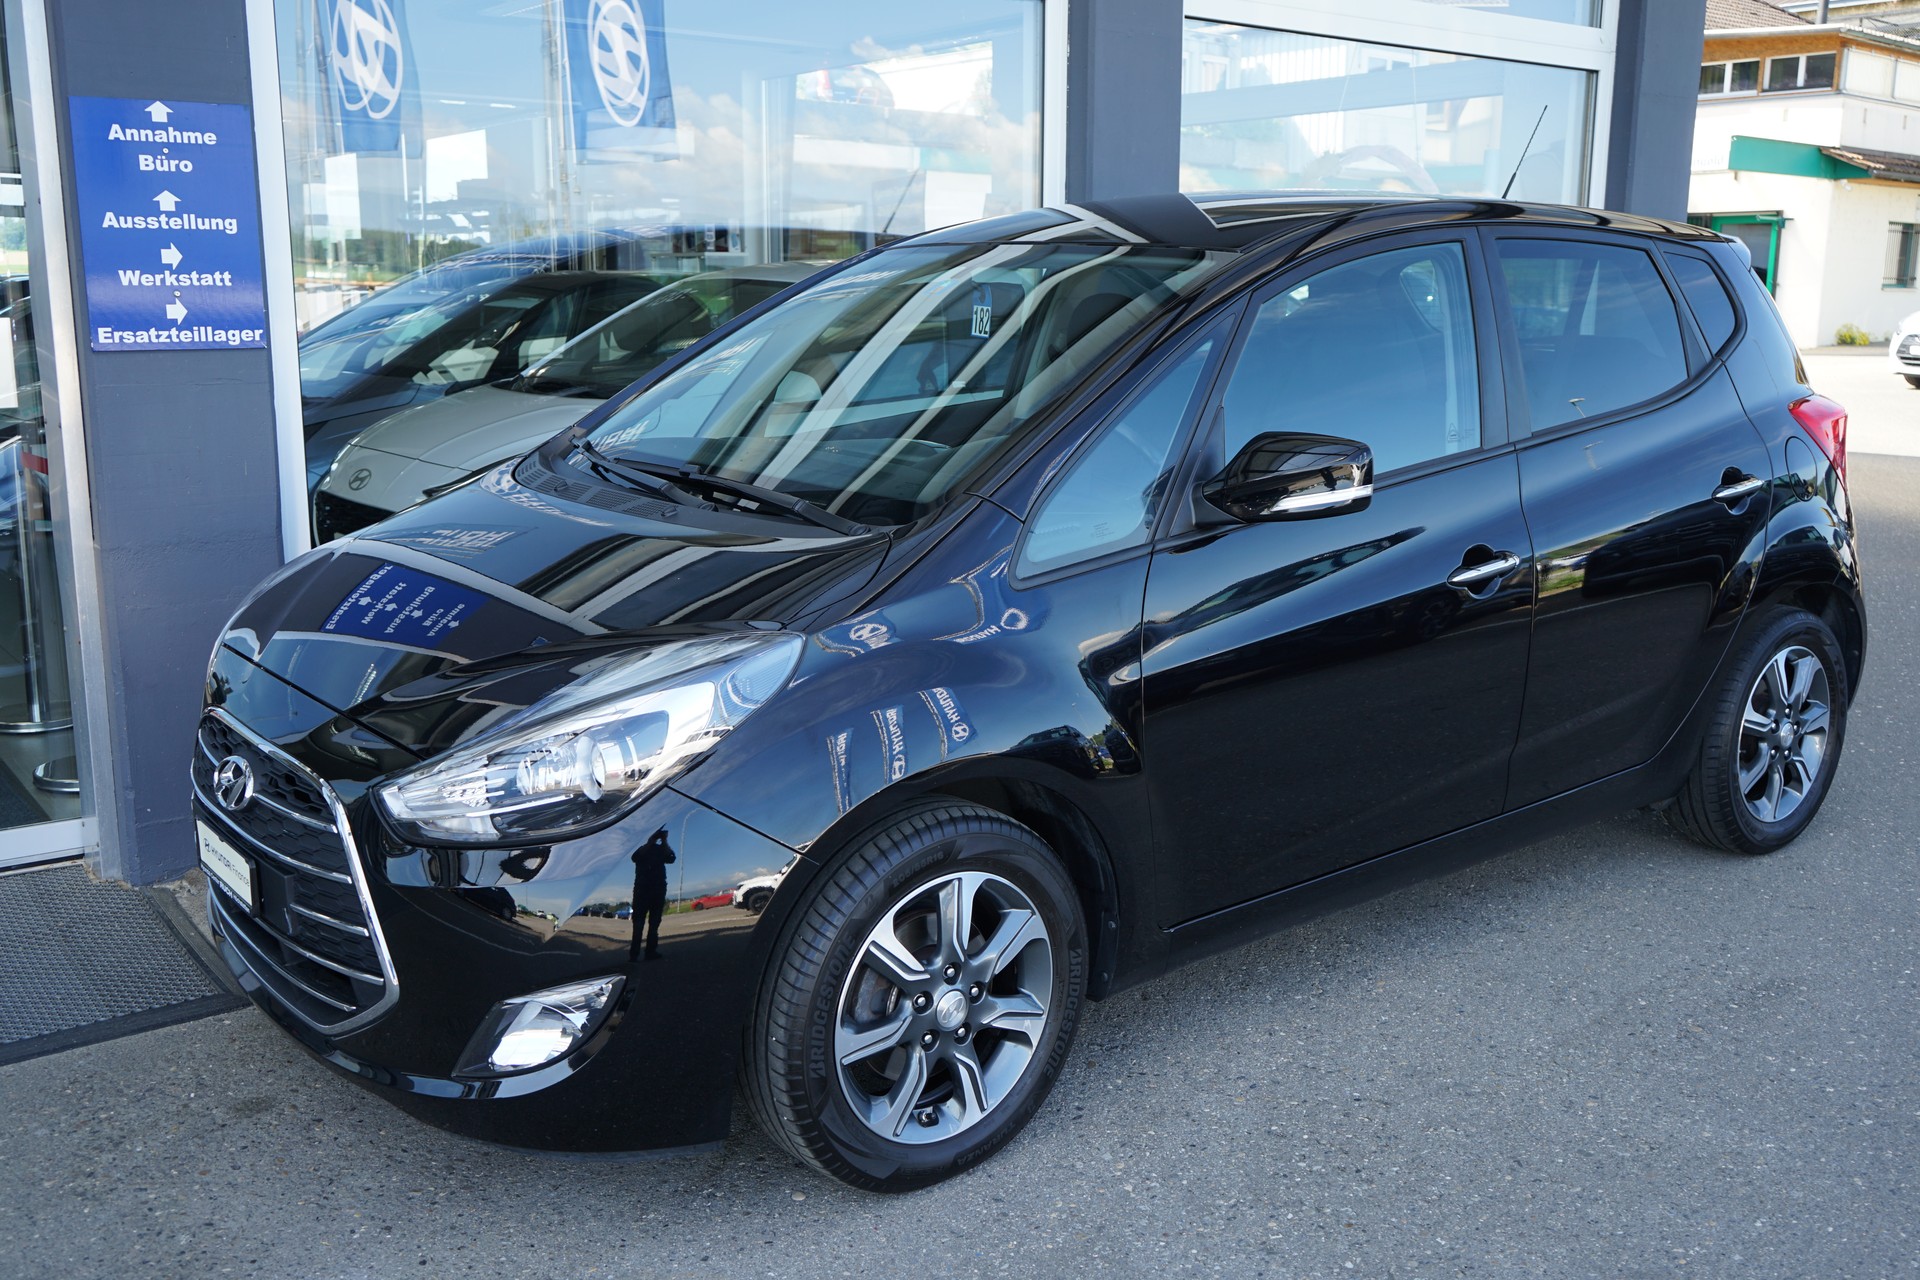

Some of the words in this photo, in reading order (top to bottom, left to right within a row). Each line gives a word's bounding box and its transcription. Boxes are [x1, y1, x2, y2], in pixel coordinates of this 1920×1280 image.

[108, 124, 217, 145] Annahme
[138, 153, 193, 173] Büro
[102, 211, 238, 235] Ausstellung
[118, 269, 232, 287] Werkstatt
[973, 306, 990, 335] 182
[97, 326, 264, 345] Ersatzteillager
[809, 932, 856, 1079] BRIDGESTONE
[1043, 948, 1083, 1079] BRIDGESTONE
